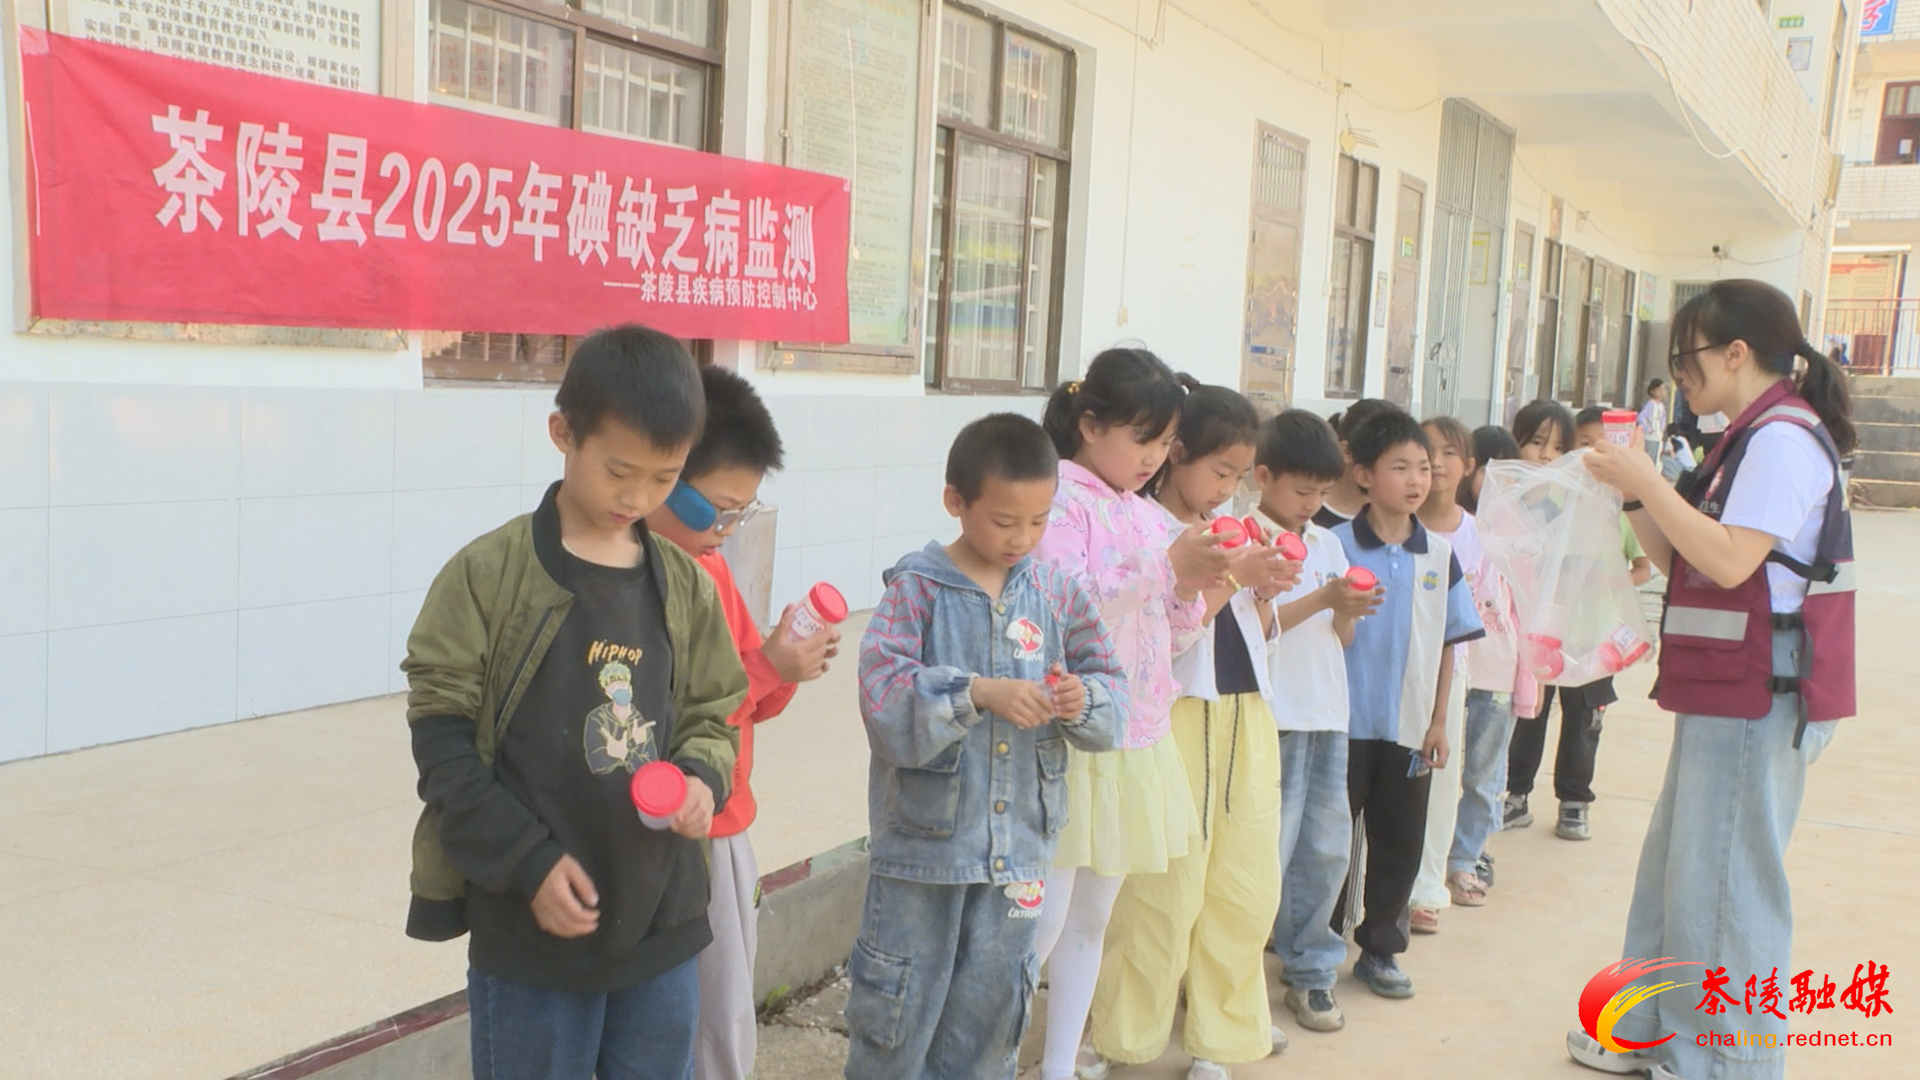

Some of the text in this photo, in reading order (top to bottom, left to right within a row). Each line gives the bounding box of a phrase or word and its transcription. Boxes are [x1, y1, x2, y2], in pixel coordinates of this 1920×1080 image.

[151, 105, 816, 282] 茶陵县2025年碘缺乏病监测
